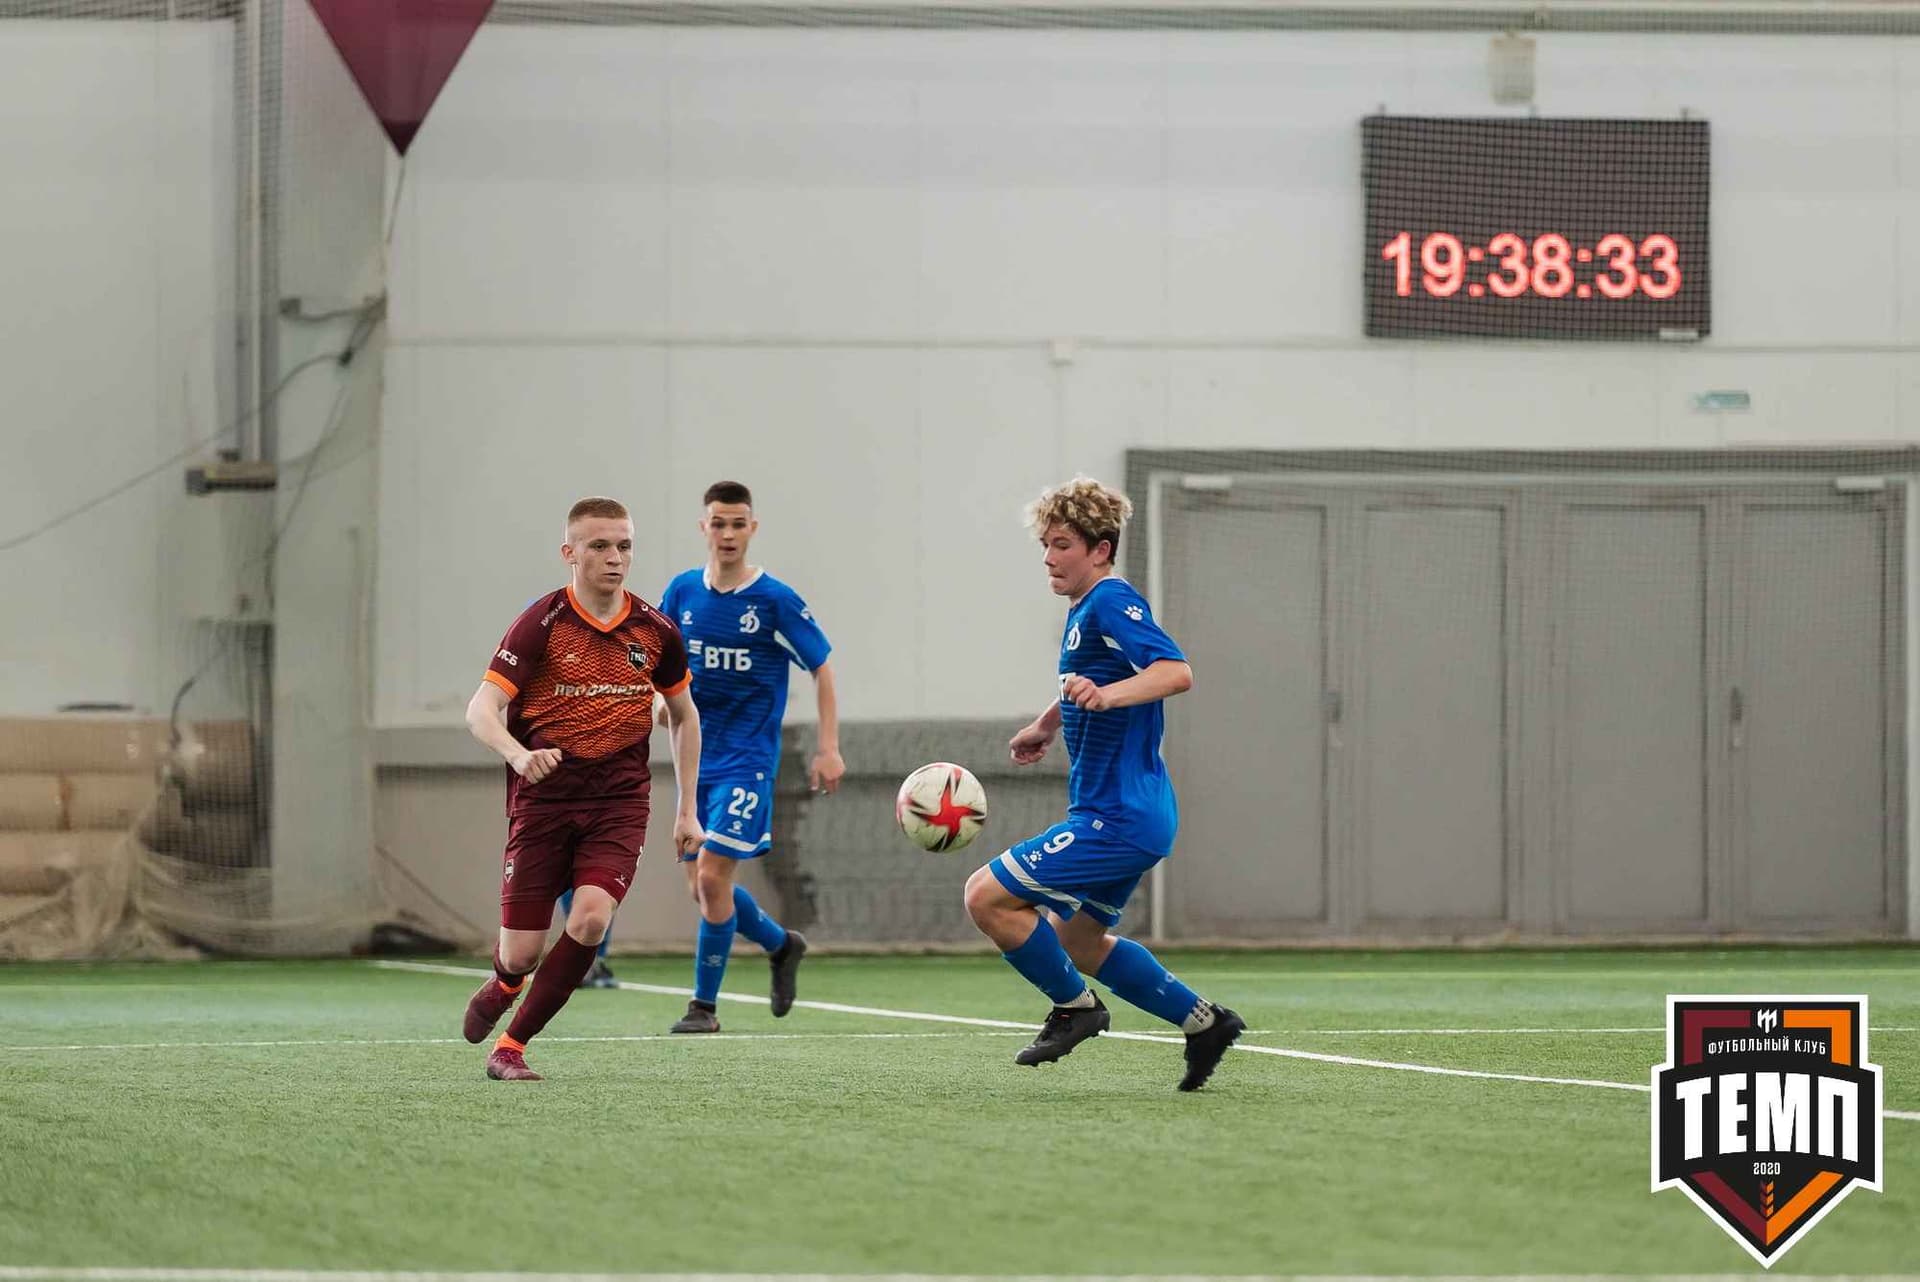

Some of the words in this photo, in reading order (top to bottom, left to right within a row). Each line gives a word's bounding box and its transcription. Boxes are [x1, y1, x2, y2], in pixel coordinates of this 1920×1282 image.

[1382, 231, 1682, 299] 19:38:33
[704, 646, 752, 671] ВТБ
[727, 787, 759, 819] 22
[1043, 831, 1076, 854] 9
